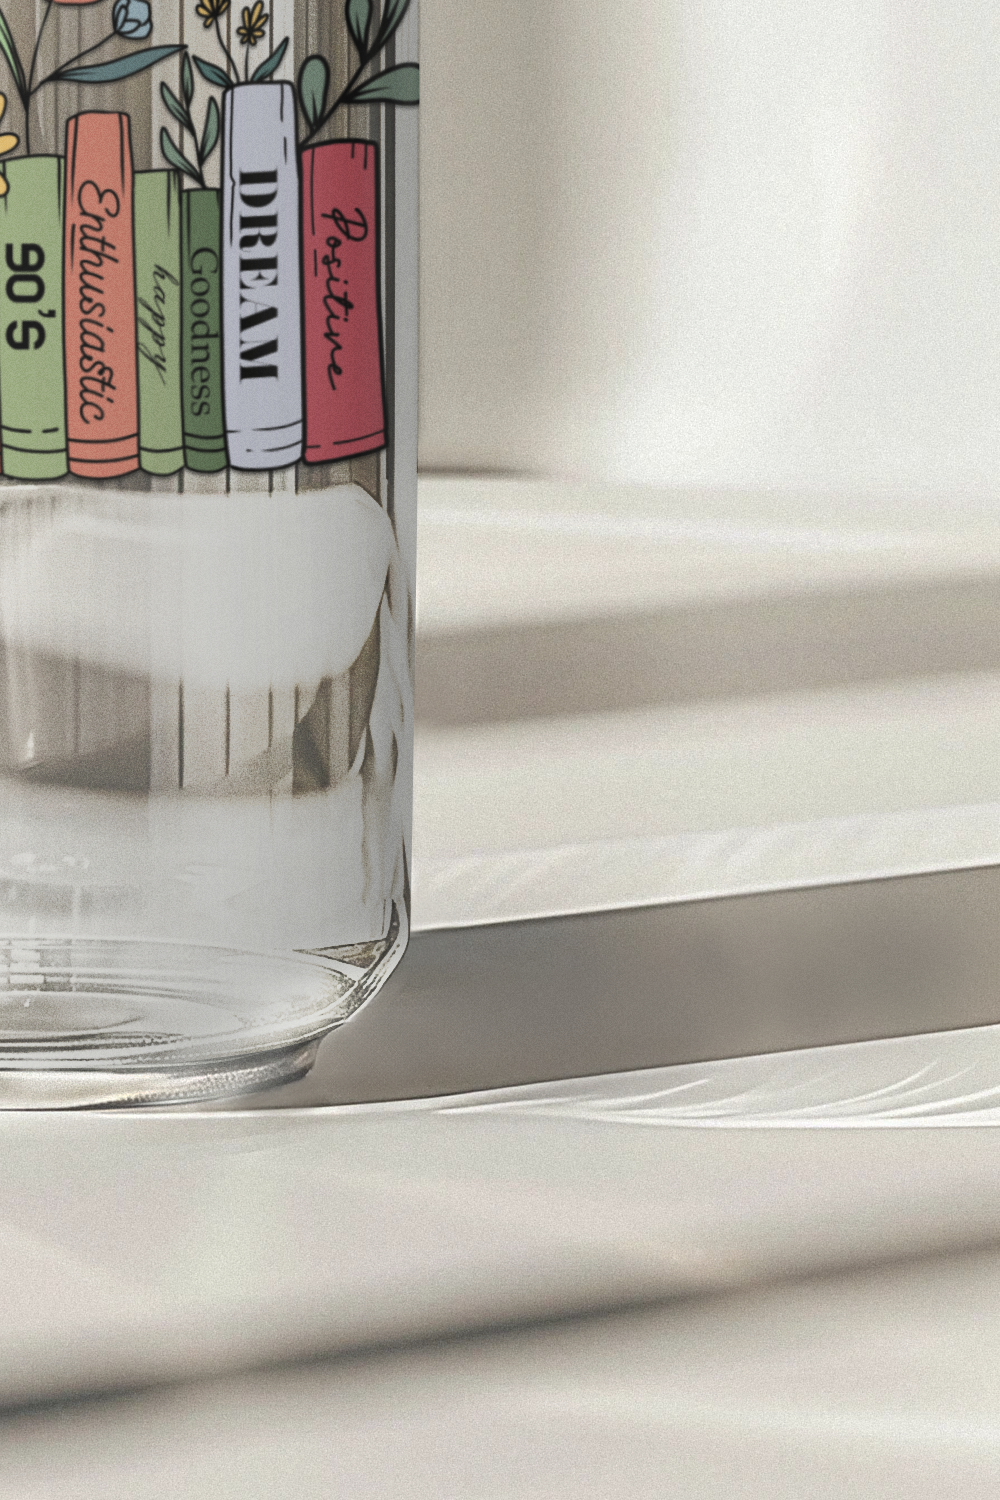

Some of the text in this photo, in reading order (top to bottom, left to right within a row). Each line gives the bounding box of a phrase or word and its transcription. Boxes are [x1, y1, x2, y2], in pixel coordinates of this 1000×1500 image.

[77, 180, 120, 425] Enthusiastic
[136, 263, 181, 386] happy
[189, 246, 220, 417] Goodness
[239, 167, 279, 383] DREAM
[321, 206, 368, 391] Positive
